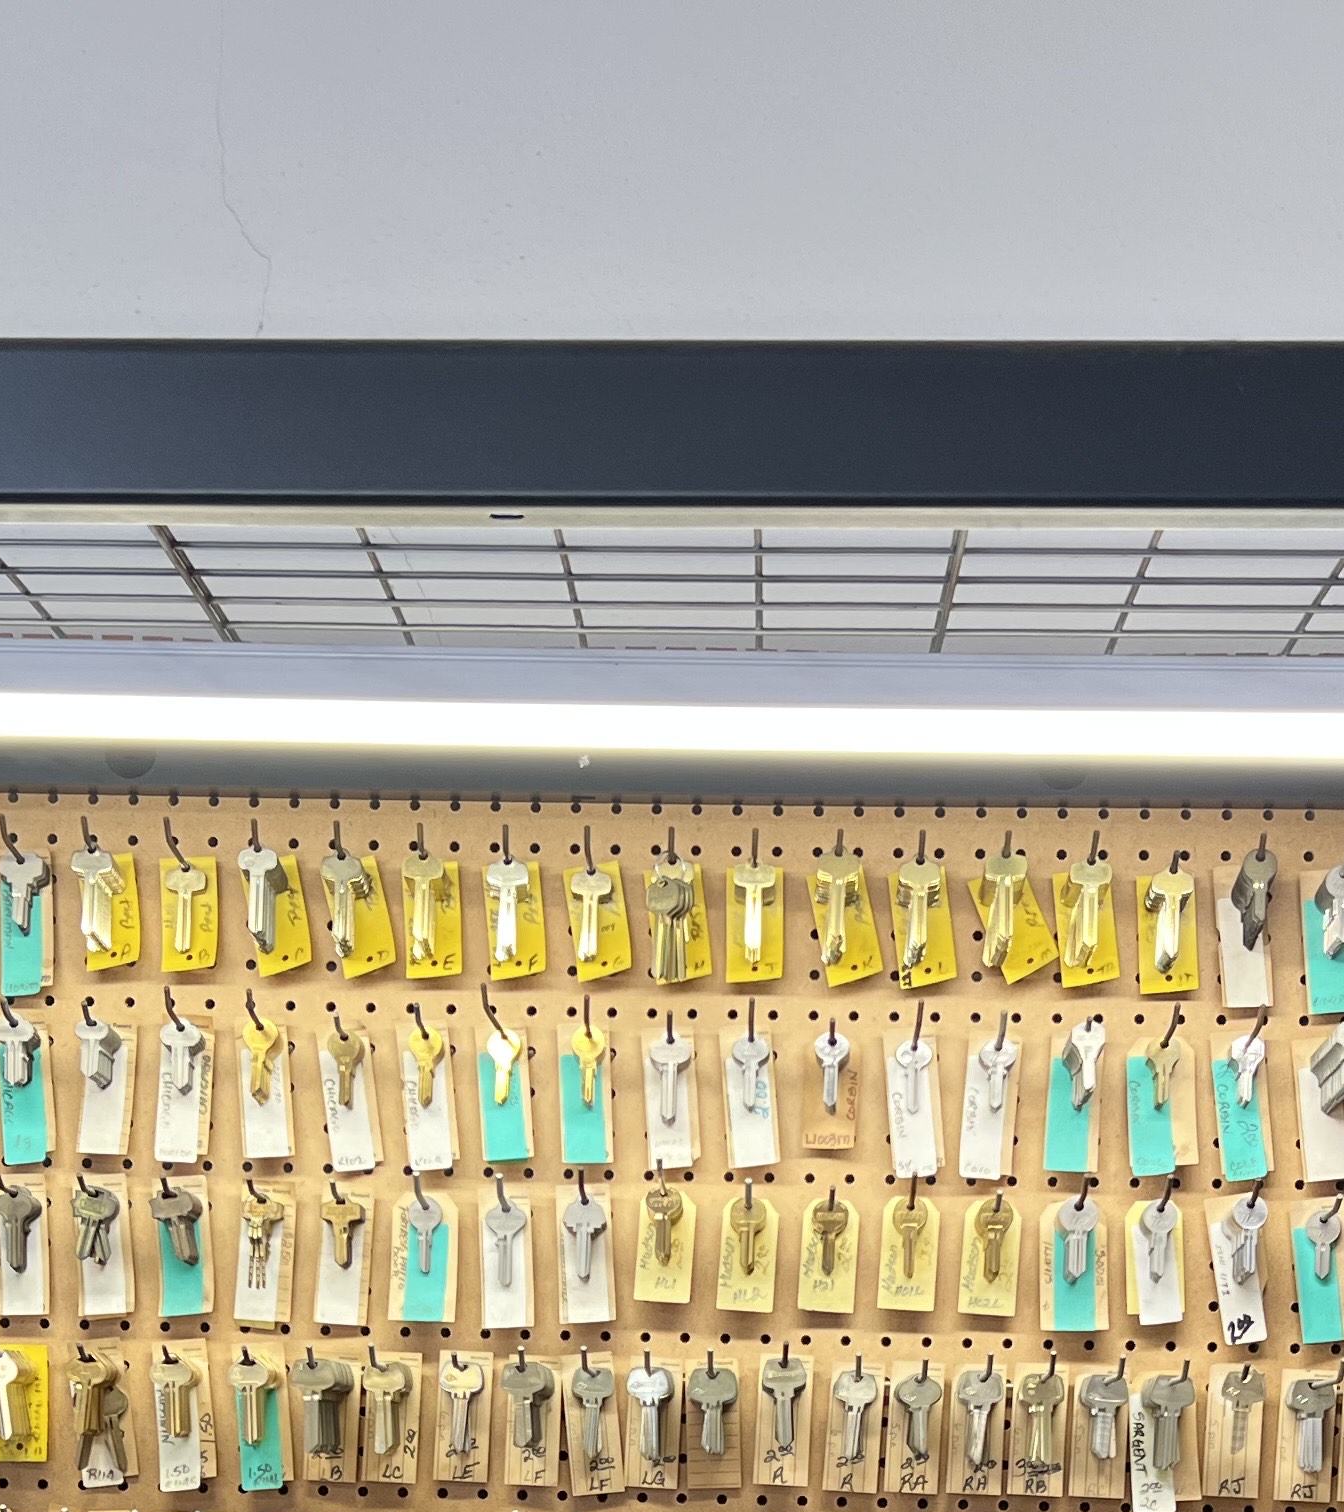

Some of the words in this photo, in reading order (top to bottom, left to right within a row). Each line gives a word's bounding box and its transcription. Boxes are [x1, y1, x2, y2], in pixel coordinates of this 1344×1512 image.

[1131, 1412, 1148, 1478] SARGENT
[1219, 1477, 1244, 1495] RJ
[1291, 1483, 1317, 1499] RJ
